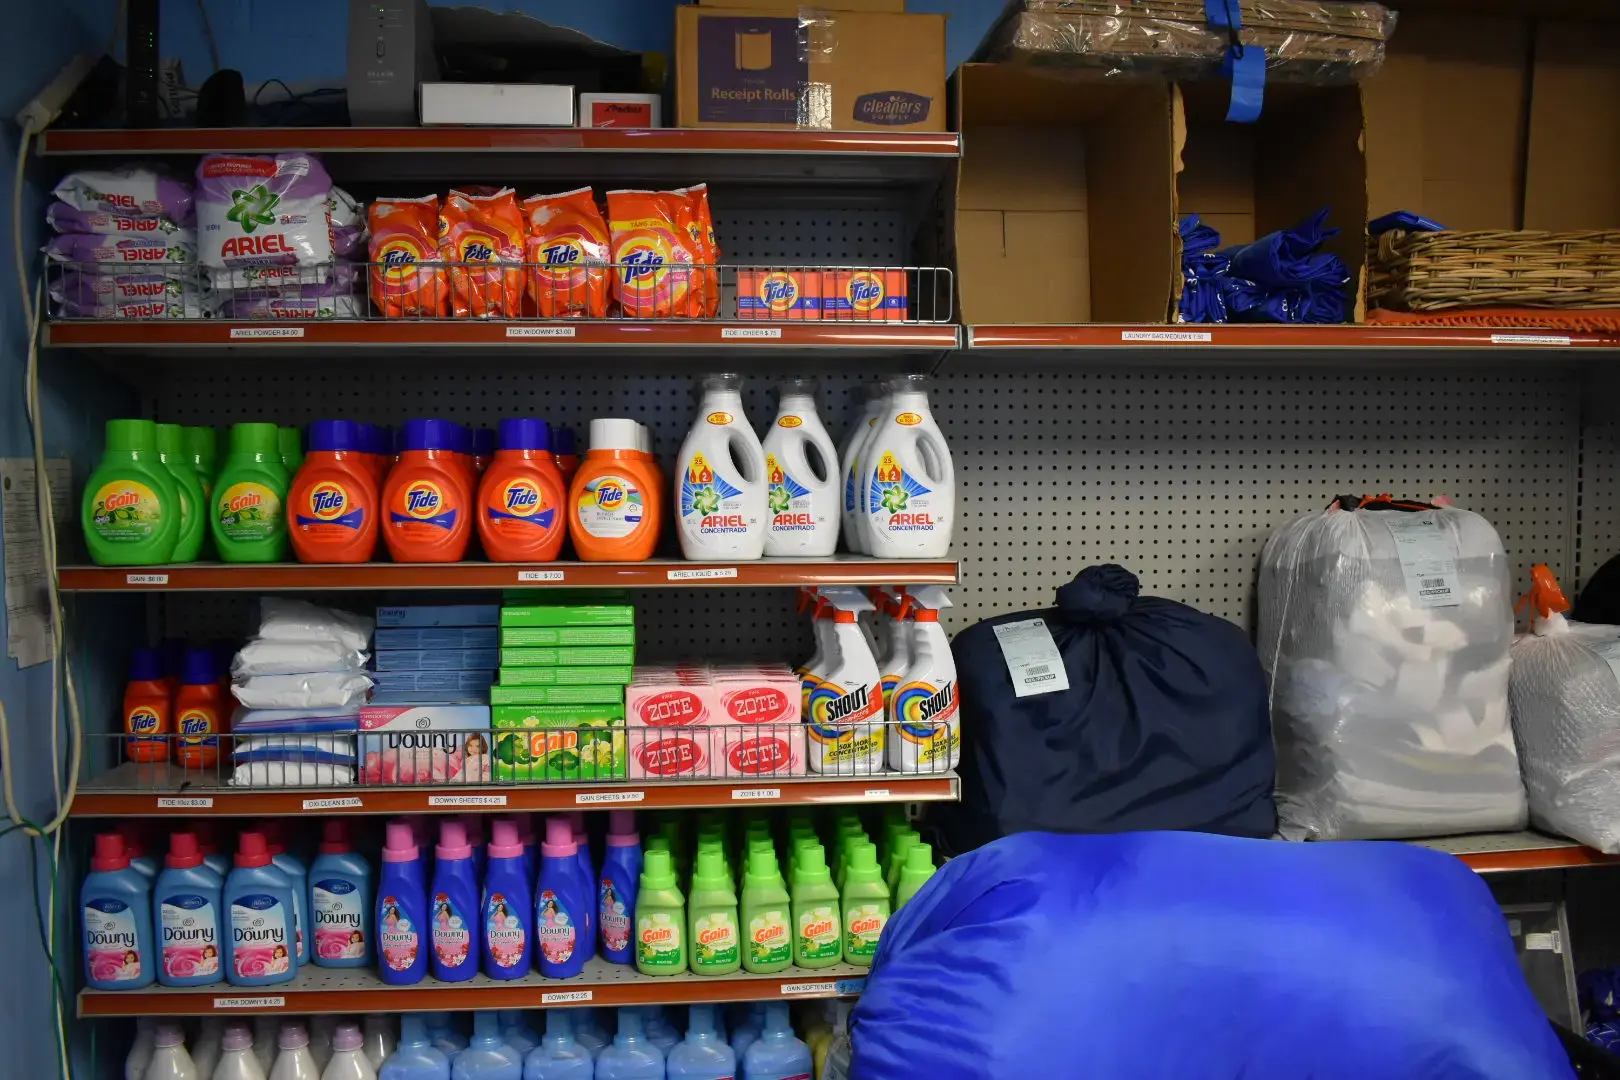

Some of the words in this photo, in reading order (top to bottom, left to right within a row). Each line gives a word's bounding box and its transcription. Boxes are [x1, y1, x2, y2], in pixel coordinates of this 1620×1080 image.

[711, 87, 761, 102] Receipt
[764, 87, 796, 101] Rolls
[863, 98, 921, 114] cleaners
[113, 217, 159, 232] ARIEL
[118, 247, 167, 261] ARIEL
[221, 233, 297, 258] ARIEL
[462, 244, 492, 263] Tide
[381, 250, 416, 275] Tide
[542, 245, 579, 270] Tide
[258, 267, 299, 279] ARIEL
[620, 251, 663, 284] Tide
[118, 282, 167, 297] ARIEL
[764, 280, 796, 304] Tide
[849, 280, 881, 304] Tide
[118, 303, 165, 318] ARIEL
[234, 329, 253, 337] ARIEL
[253, 328, 282, 336] POWDER
[105, 491, 140, 511] Gain
[229, 492, 262, 512] Gain
[313, 491, 344, 514] Tide
[407, 490, 439, 513] Tide
[507, 488, 538, 508] Tide
[598, 487, 624, 505] Tide
[700, 514, 747, 528] ARIEL
[772, 514, 815, 526] ARIEL
[888, 513, 934, 525] ARIEL
[647, 697, 694, 722] ZOTE
[734, 693, 782, 717] ZOTE
[825, 683, 868, 722] SHOUT
[919, 680, 952, 721] SHOUT
[131, 714, 158, 733] Tide
[181, 718, 208, 735] Tide
[388, 732, 457, 755] Downy
[530, 729, 578, 758] Gain
[647, 743, 693, 768] ZOTE
[736, 743, 782, 767] ZOTE
[315, 910, 360, 928] Downy
[601, 912, 626, 926] Downy
[851, 918, 881, 935] Gain
[163, 927, 214, 943] Downy
[233, 927, 284, 943] Downy
[382, 932, 412, 942] Downy
[434, 929, 464, 939] Downy
[490, 929, 520, 940] Downy
[540, 925, 570, 937] Downy
[642, 928, 672, 944] Gain
[700, 927, 730, 944] Gain
[754, 925, 784, 944] Gain
[804, 920, 832, 938] Gain
[87, 930, 135, 948] Downy
